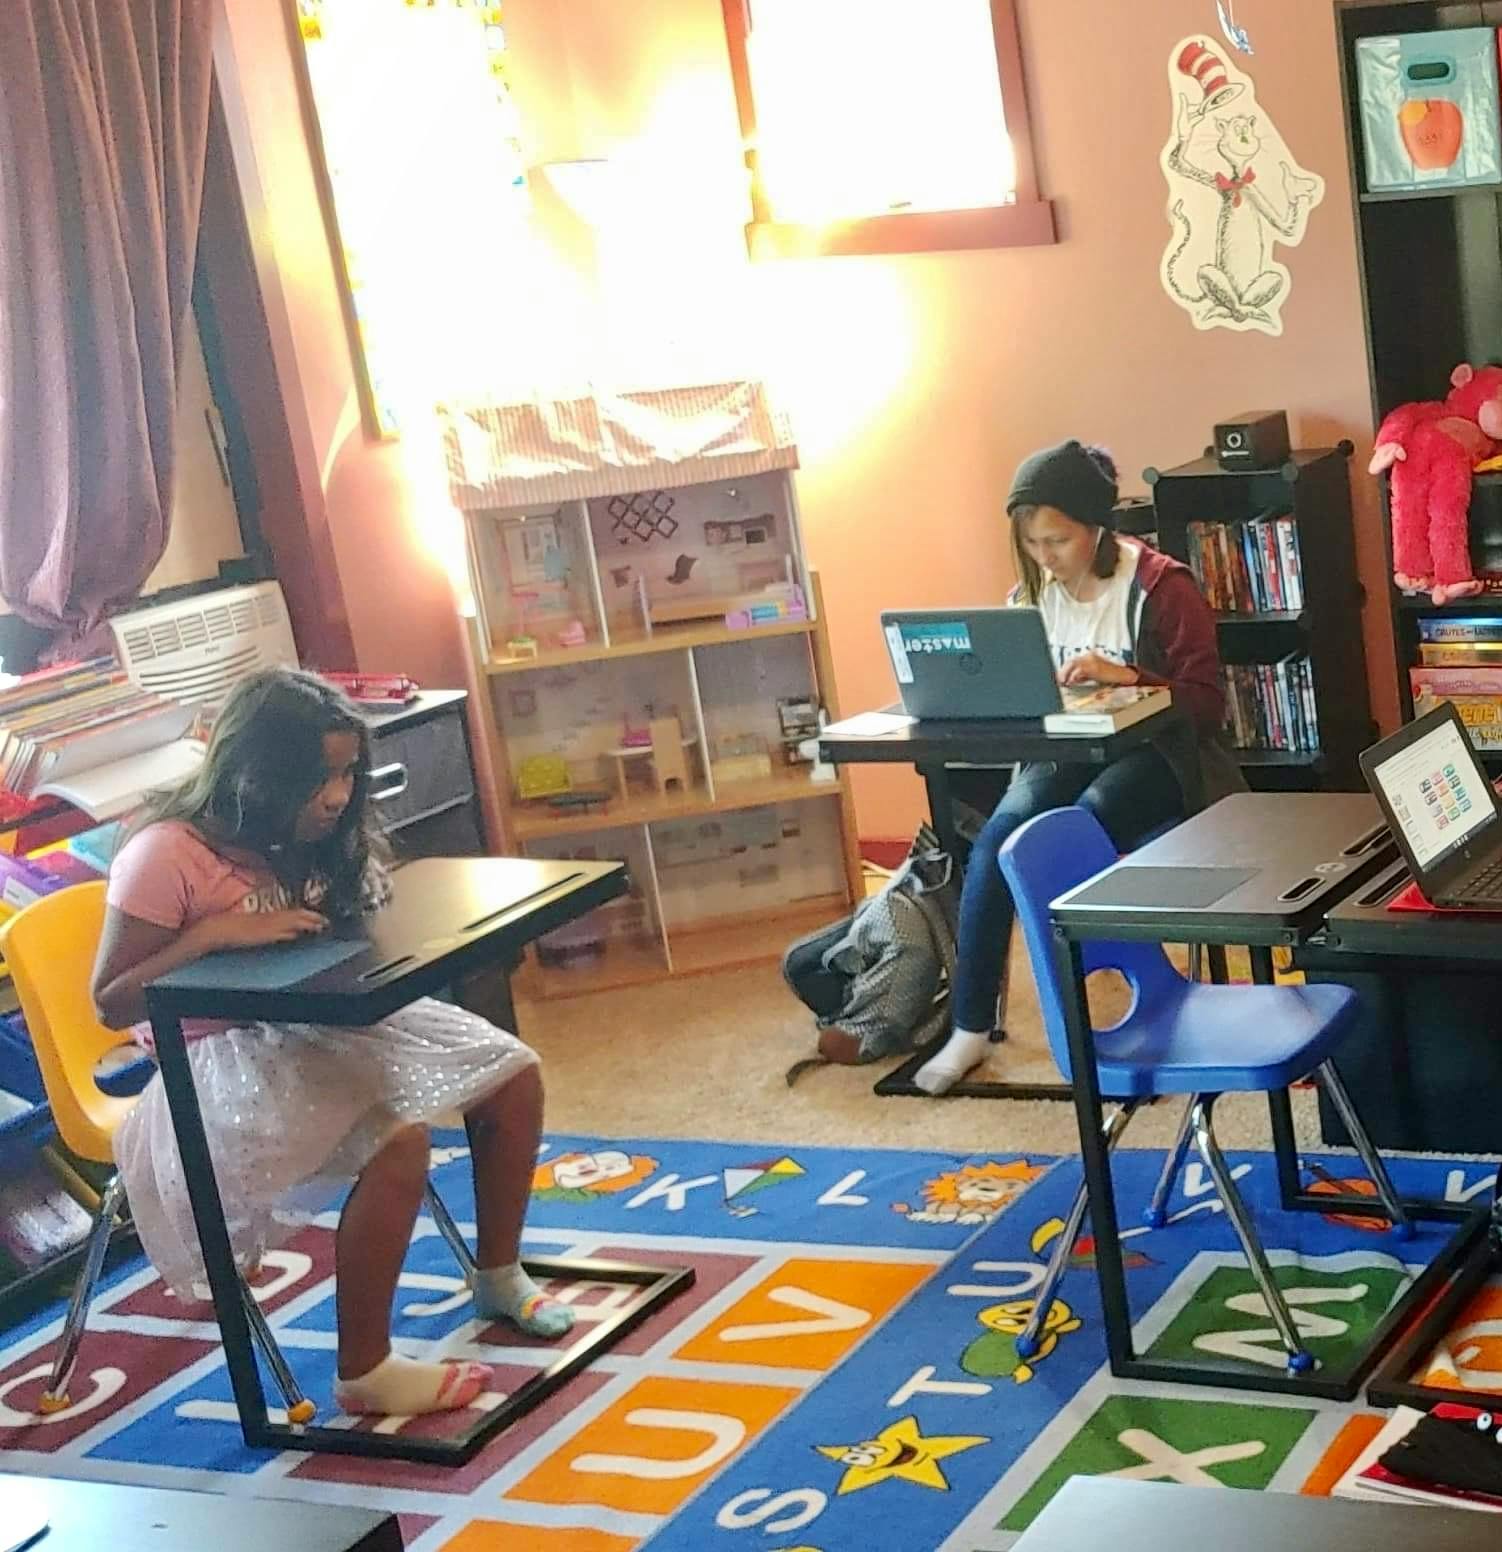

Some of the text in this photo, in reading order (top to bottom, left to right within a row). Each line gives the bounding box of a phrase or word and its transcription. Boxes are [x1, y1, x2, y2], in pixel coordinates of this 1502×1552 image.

[624, 1173, 719, 1211] K
[816, 1169, 870, 1206] L
[946, 1261, 1050, 1297] U
[719, 1285, 873, 1343] V
[886, 1366, 993, 1408] T
[569, 1407, 747, 1480] U
[1089, 1428, 1267, 1489] X
[716, 1487, 829, 1534] S
